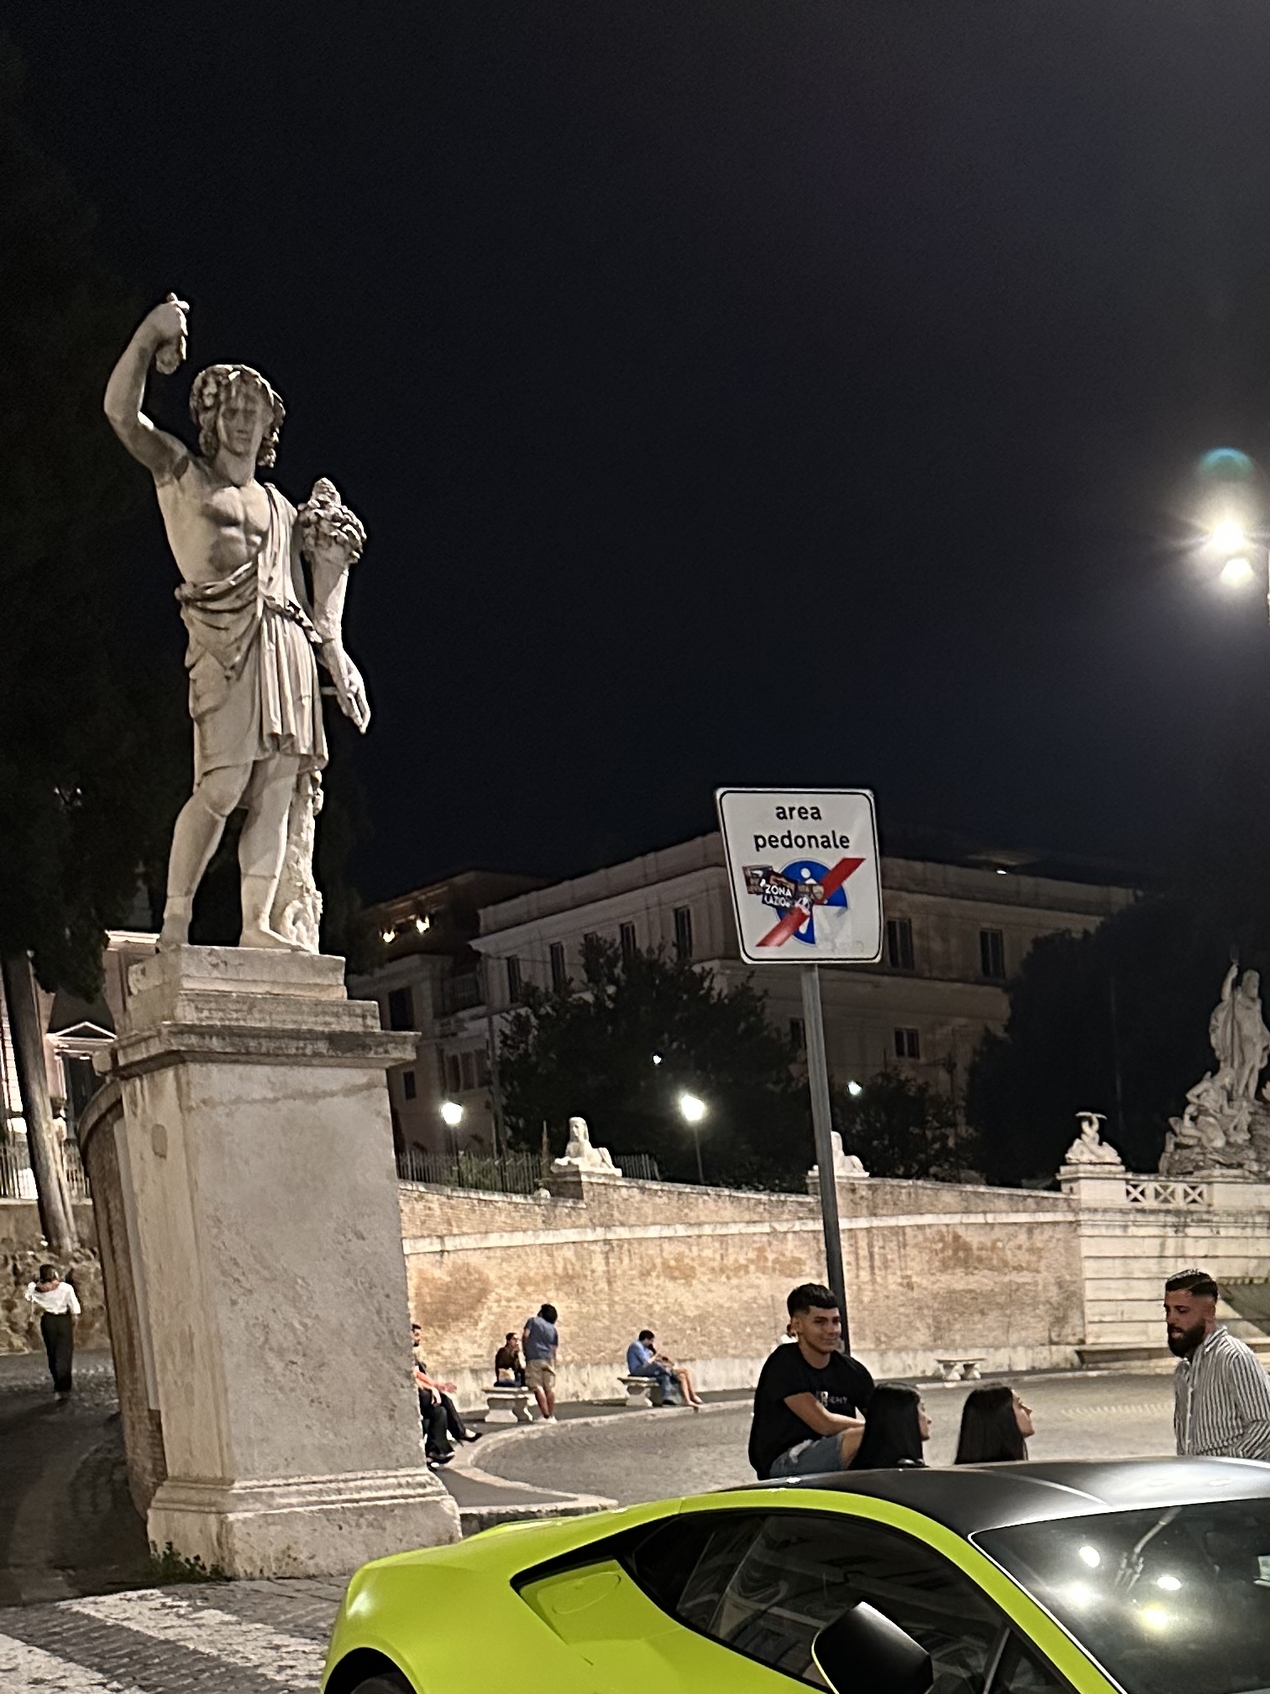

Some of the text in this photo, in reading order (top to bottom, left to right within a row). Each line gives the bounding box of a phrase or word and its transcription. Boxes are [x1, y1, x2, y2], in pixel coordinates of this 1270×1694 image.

[775, 806, 822, 820] area
[753, 830, 850, 852] pedonale
[765, 884, 792, 897] ZONA
